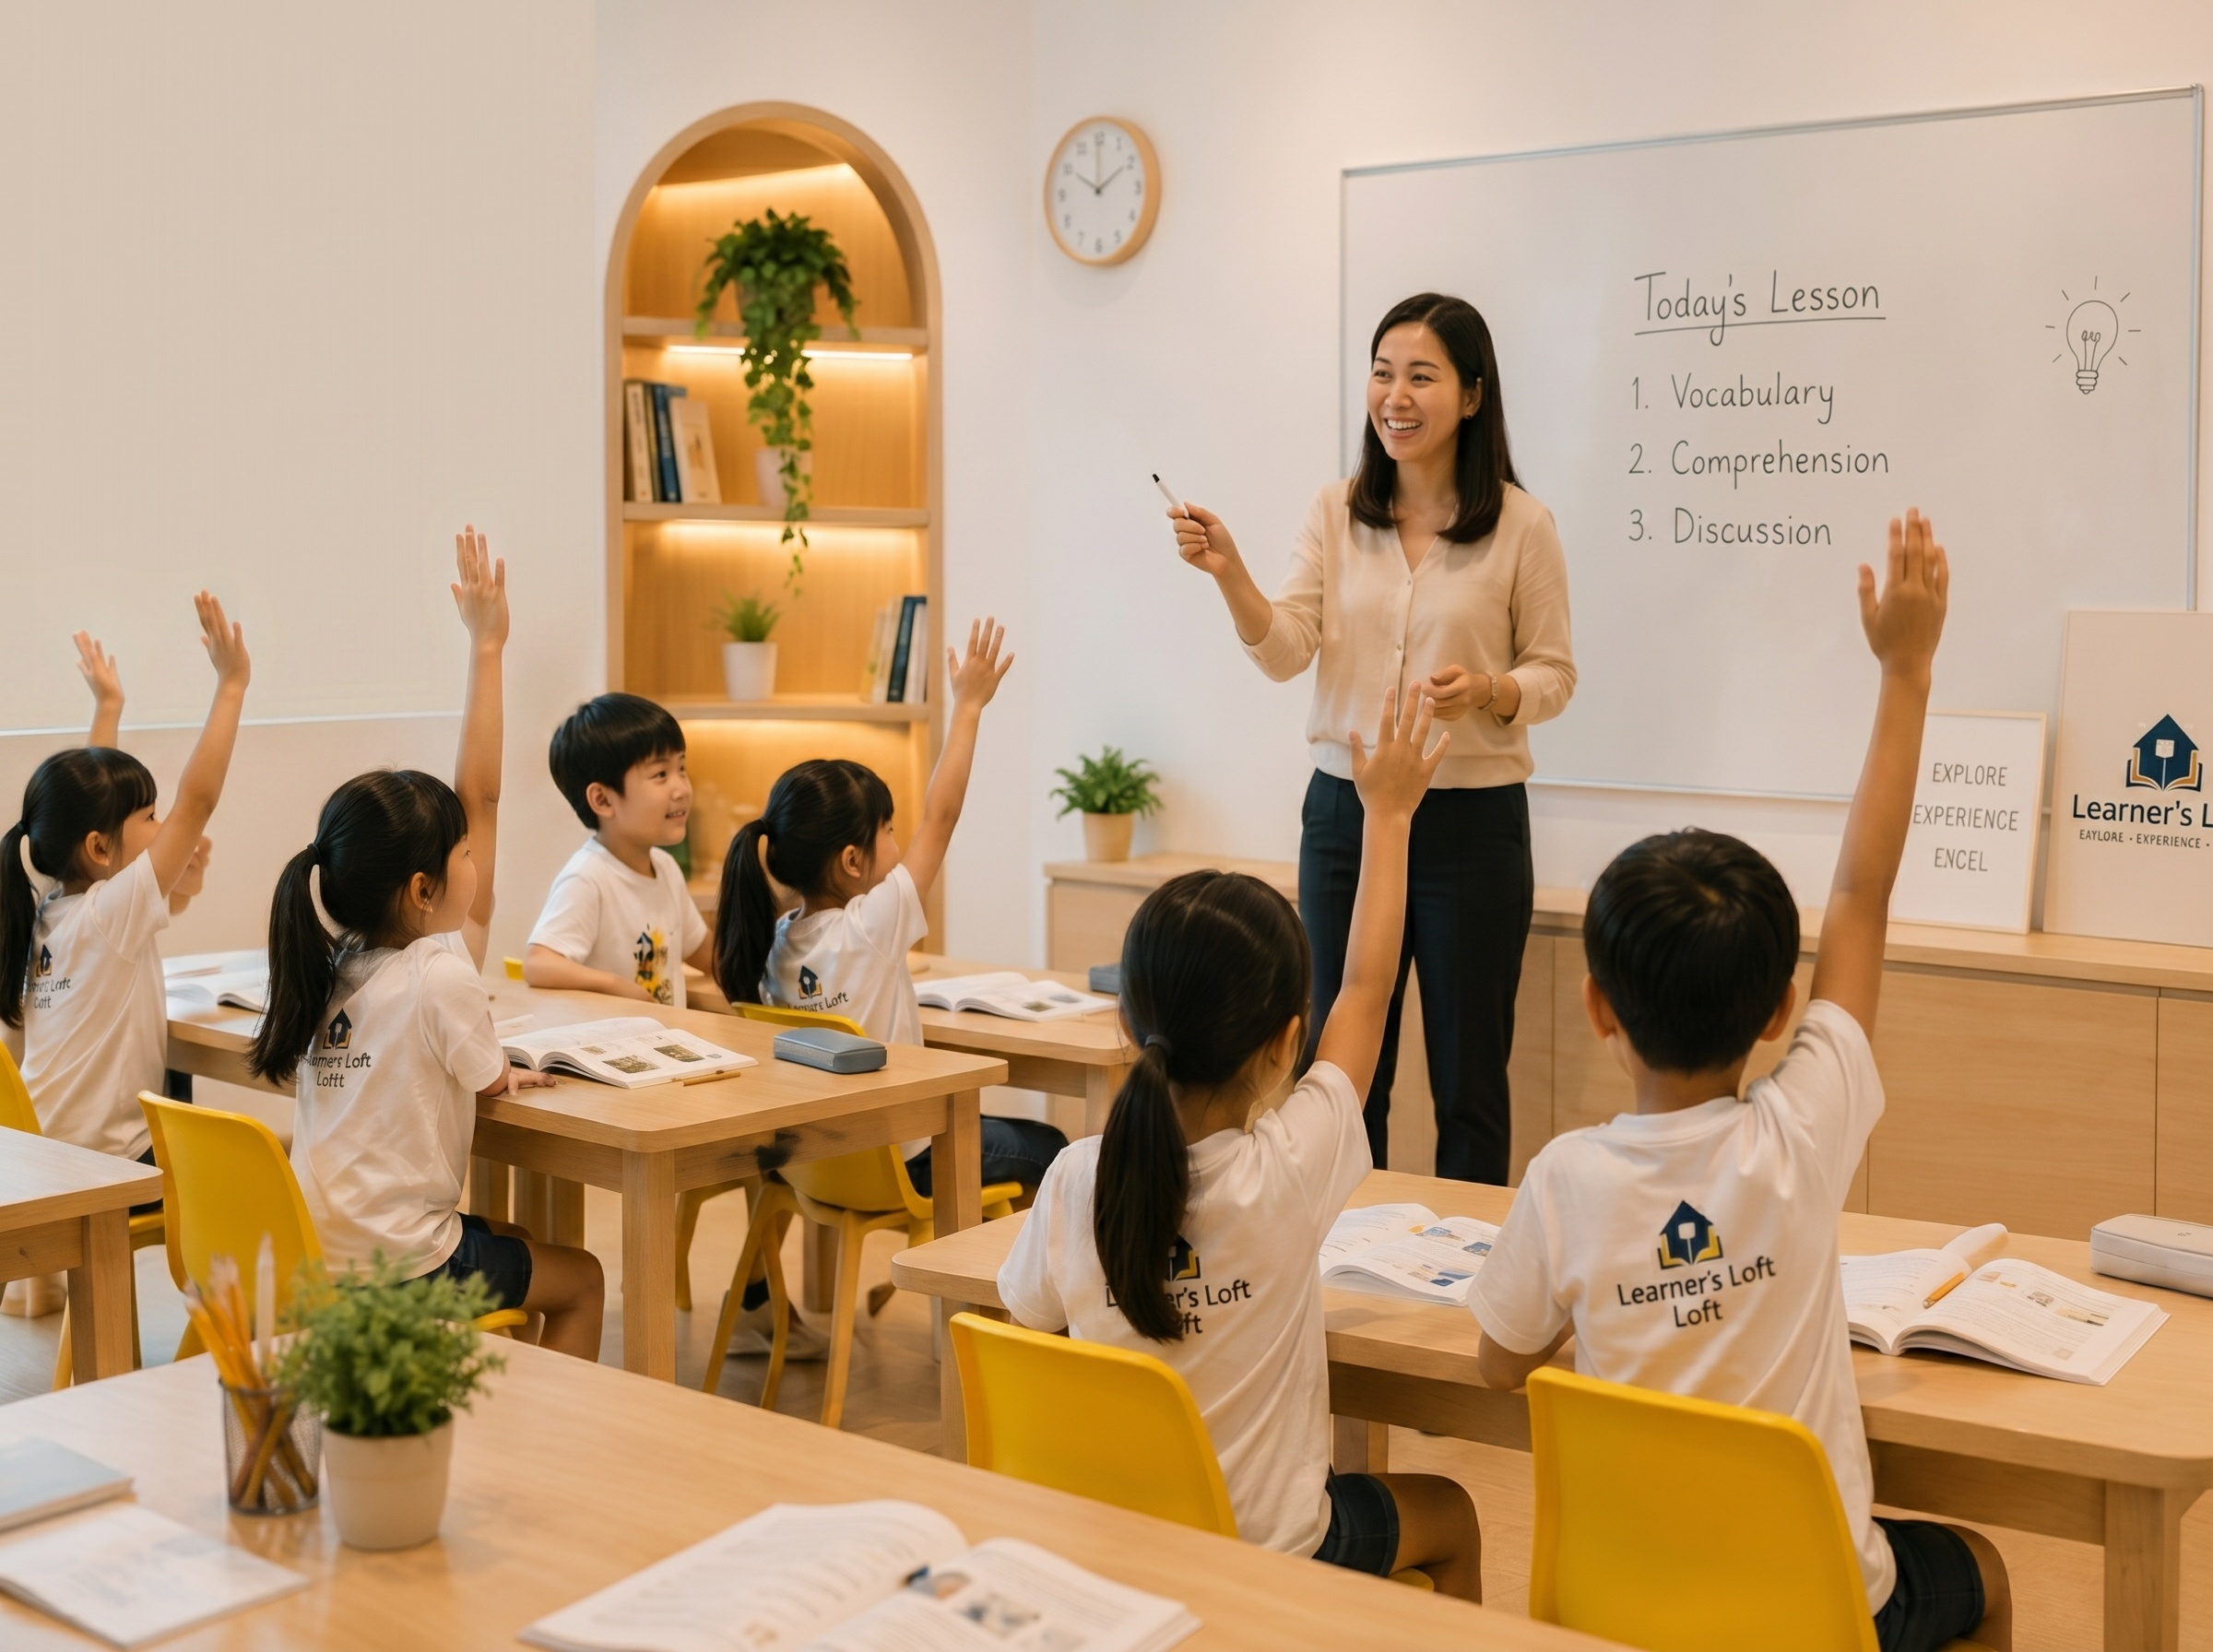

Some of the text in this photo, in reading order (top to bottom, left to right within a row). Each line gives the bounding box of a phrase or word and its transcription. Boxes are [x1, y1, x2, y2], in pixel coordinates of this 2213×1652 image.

[1634, 269, 1880, 347] Today's Lesson
[1631, 371, 1834, 424] 1. Vocabulary
[1627, 439, 1889, 490] 2. Comprehension
[1627, 507, 1831, 546] 3. Discussion
[1933, 762, 2008, 786] EXPLORE
[1912, 804, 2019, 832] EXPERIENCE
[2072, 794, 2213, 828] Learner's L
[2136, 832, 2201, 849] EXPERIENCE
[1934, 847, 1988, 872] ENCEL
[345, 1052, 372, 1068] Loft
[1106, 1279, 1251, 1308] Ler's Loft
[1616, 1256, 1777, 1306] Learner's Loft
[1674, 1299, 1723, 1328] Loft
